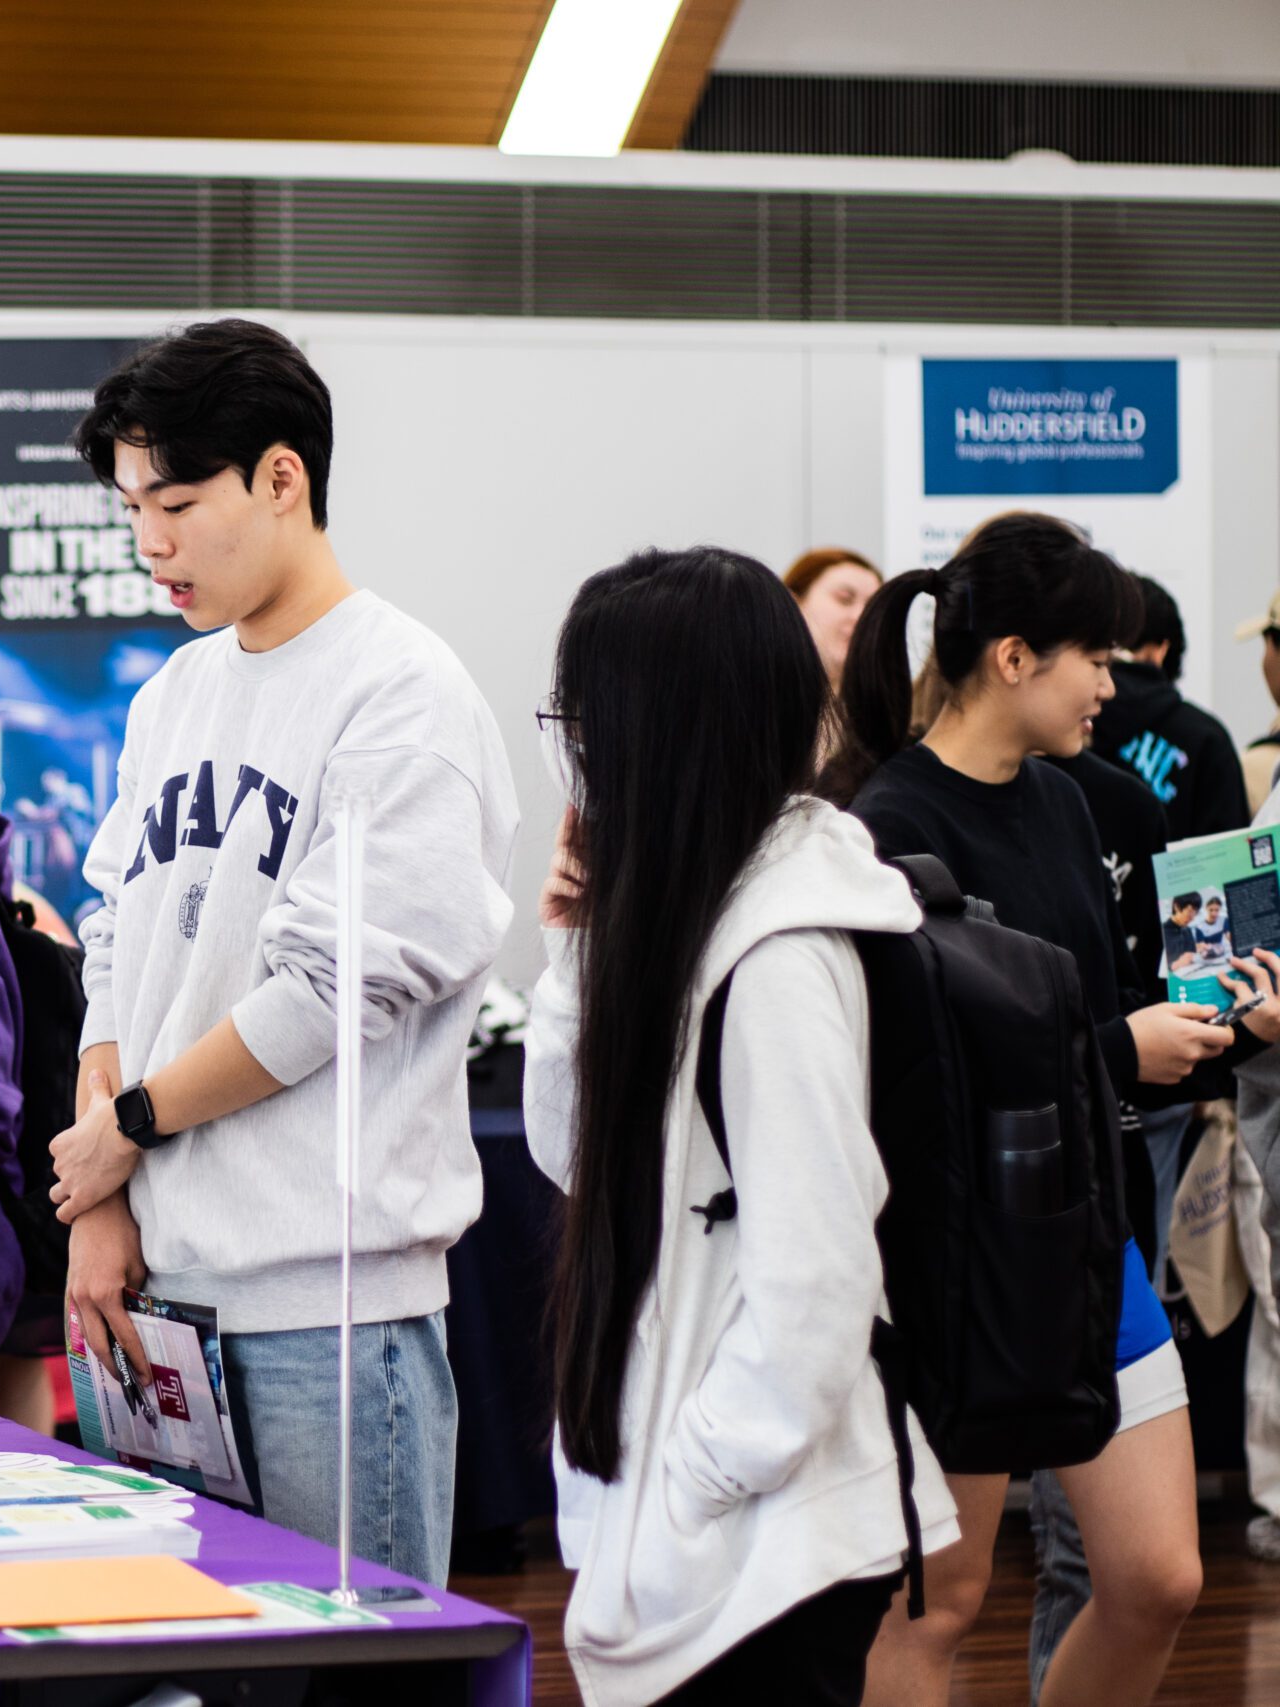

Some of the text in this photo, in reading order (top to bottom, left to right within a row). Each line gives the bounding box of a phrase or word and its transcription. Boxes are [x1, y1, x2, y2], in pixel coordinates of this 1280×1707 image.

[988, 386, 1116, 411] University of
[955, 406, 1146, 443] HUDDERSFIELD
[9, 529, 56, 574] IN
[58, 527, 134, 572] THE
[0, 574, 79, 620] SINCE
